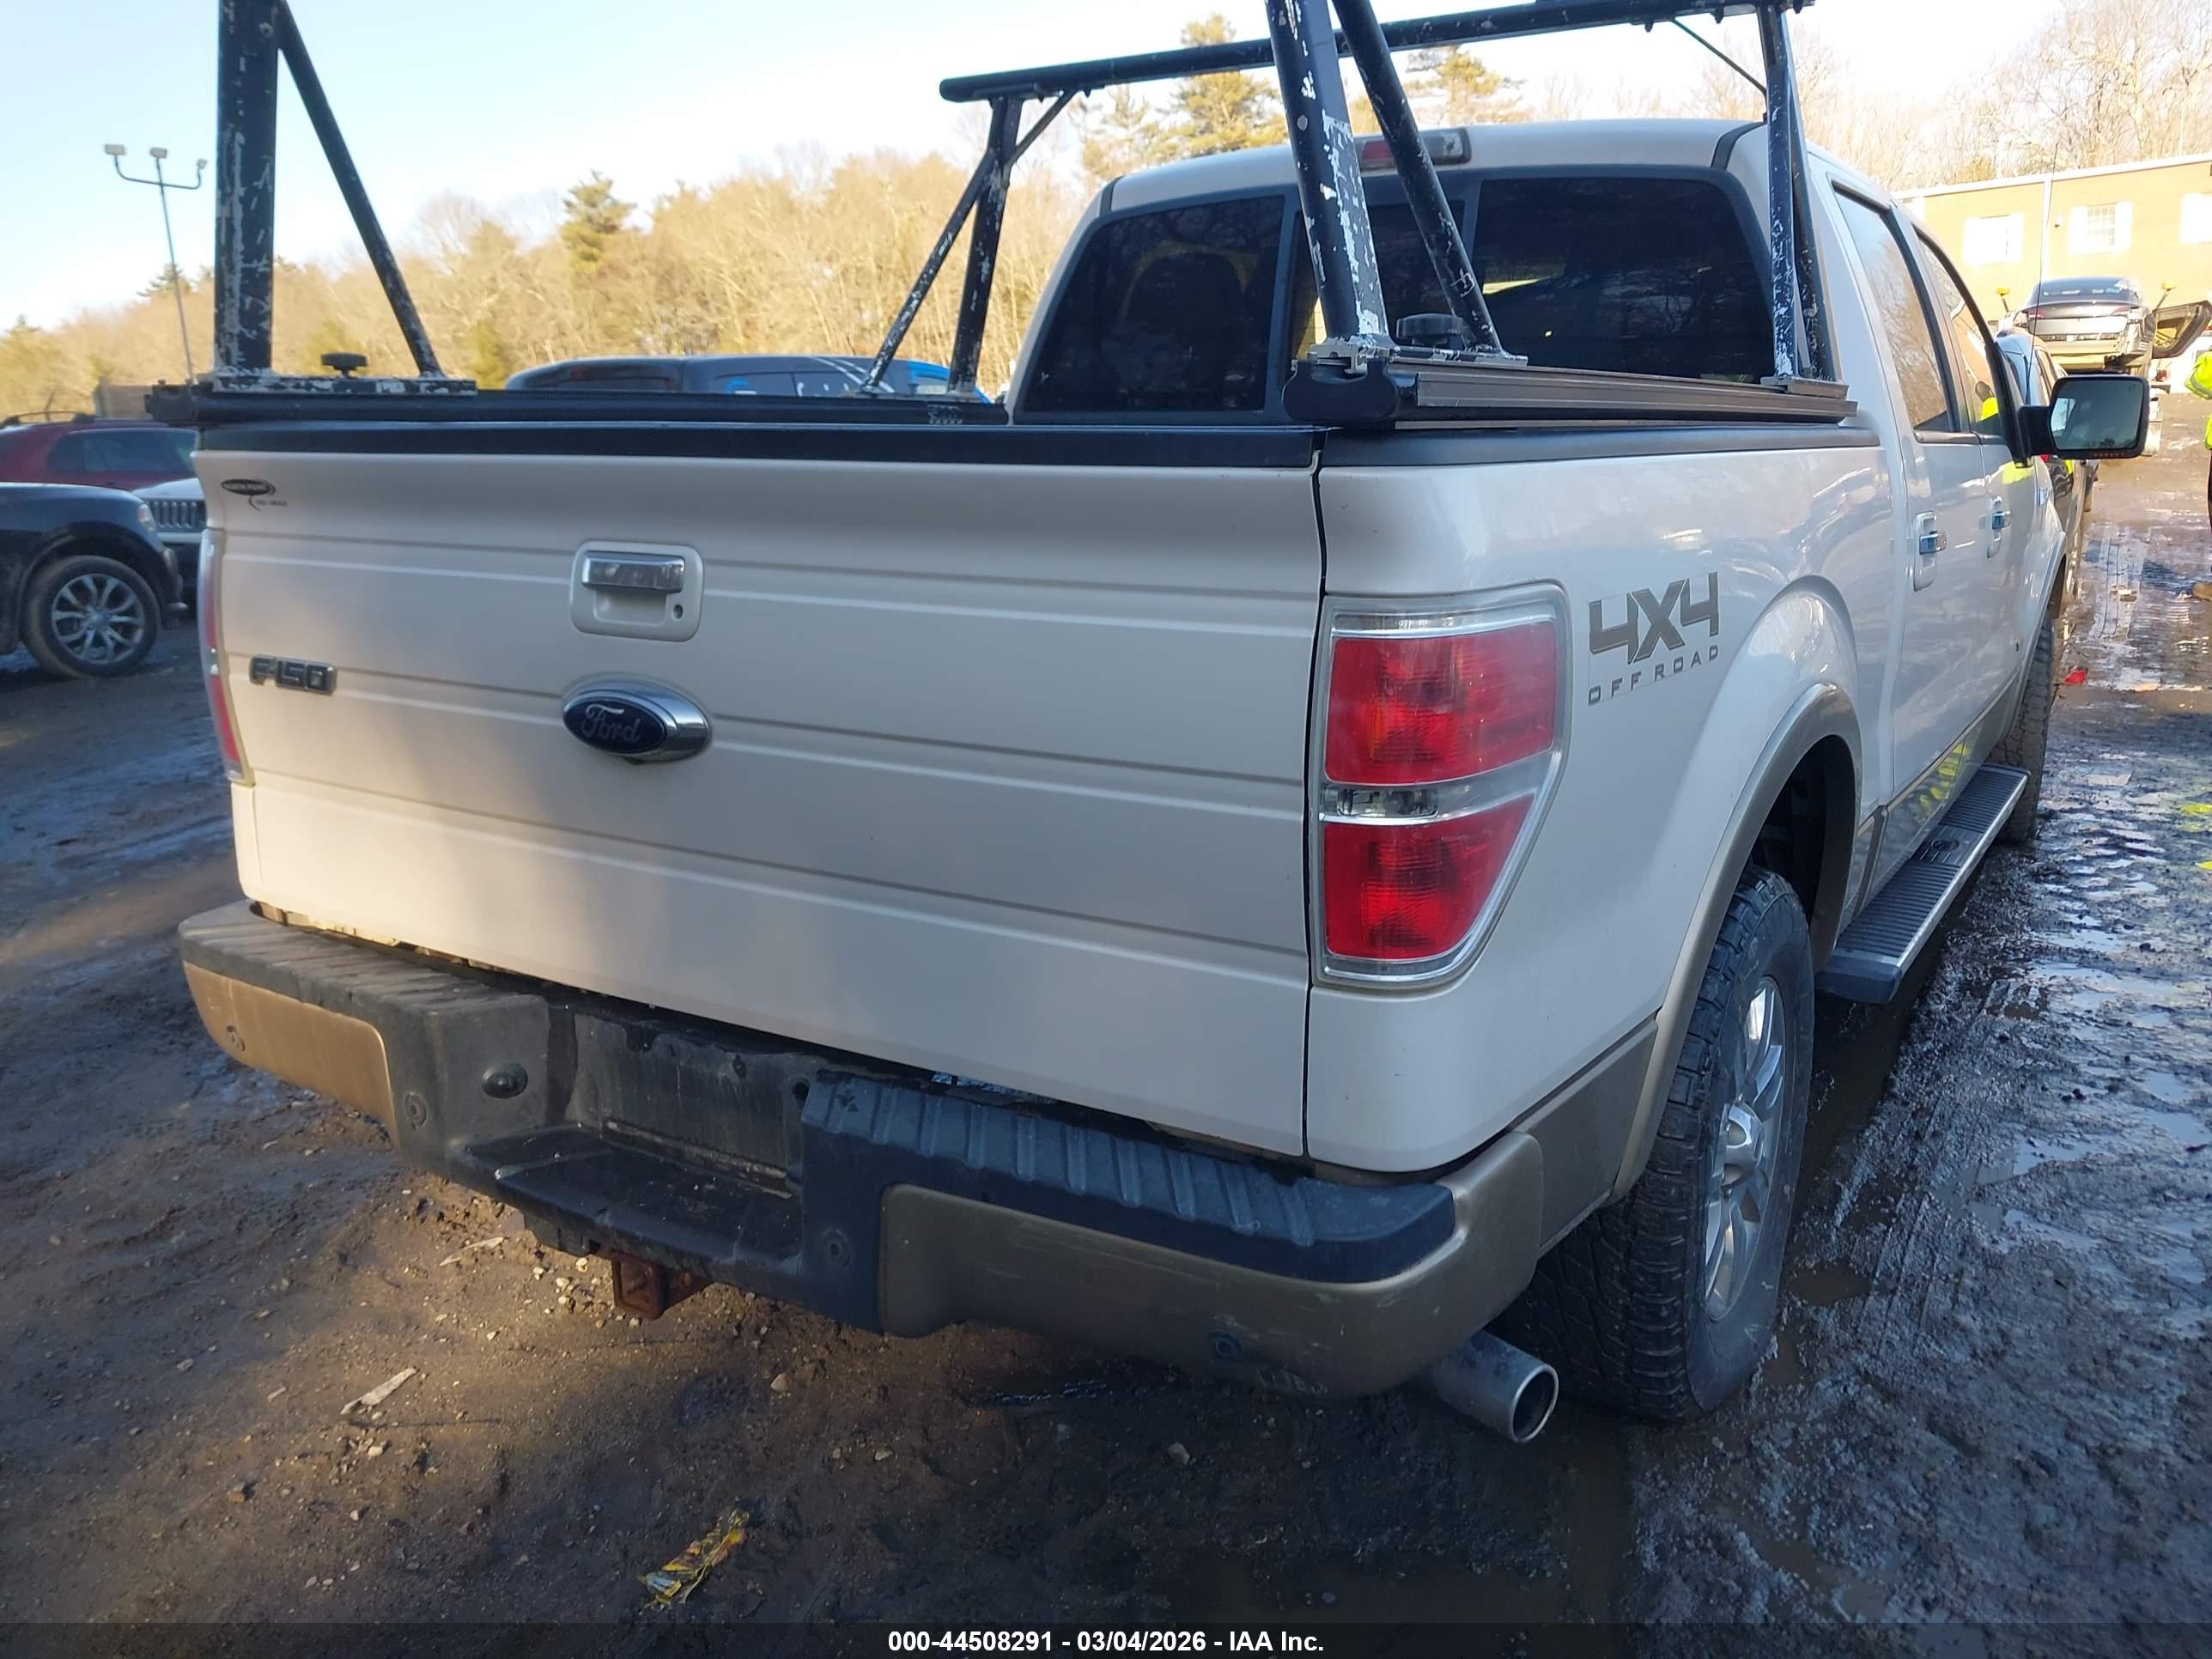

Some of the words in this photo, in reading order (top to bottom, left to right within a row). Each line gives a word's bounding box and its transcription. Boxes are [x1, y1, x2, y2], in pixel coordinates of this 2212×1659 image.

[1589, 572, 1718, 665] 4X4
[1589, 671, 1642, 706] OFF
[1655, 645, 1718, 682] ROAD
[580, 703, 641, 742] Ford
